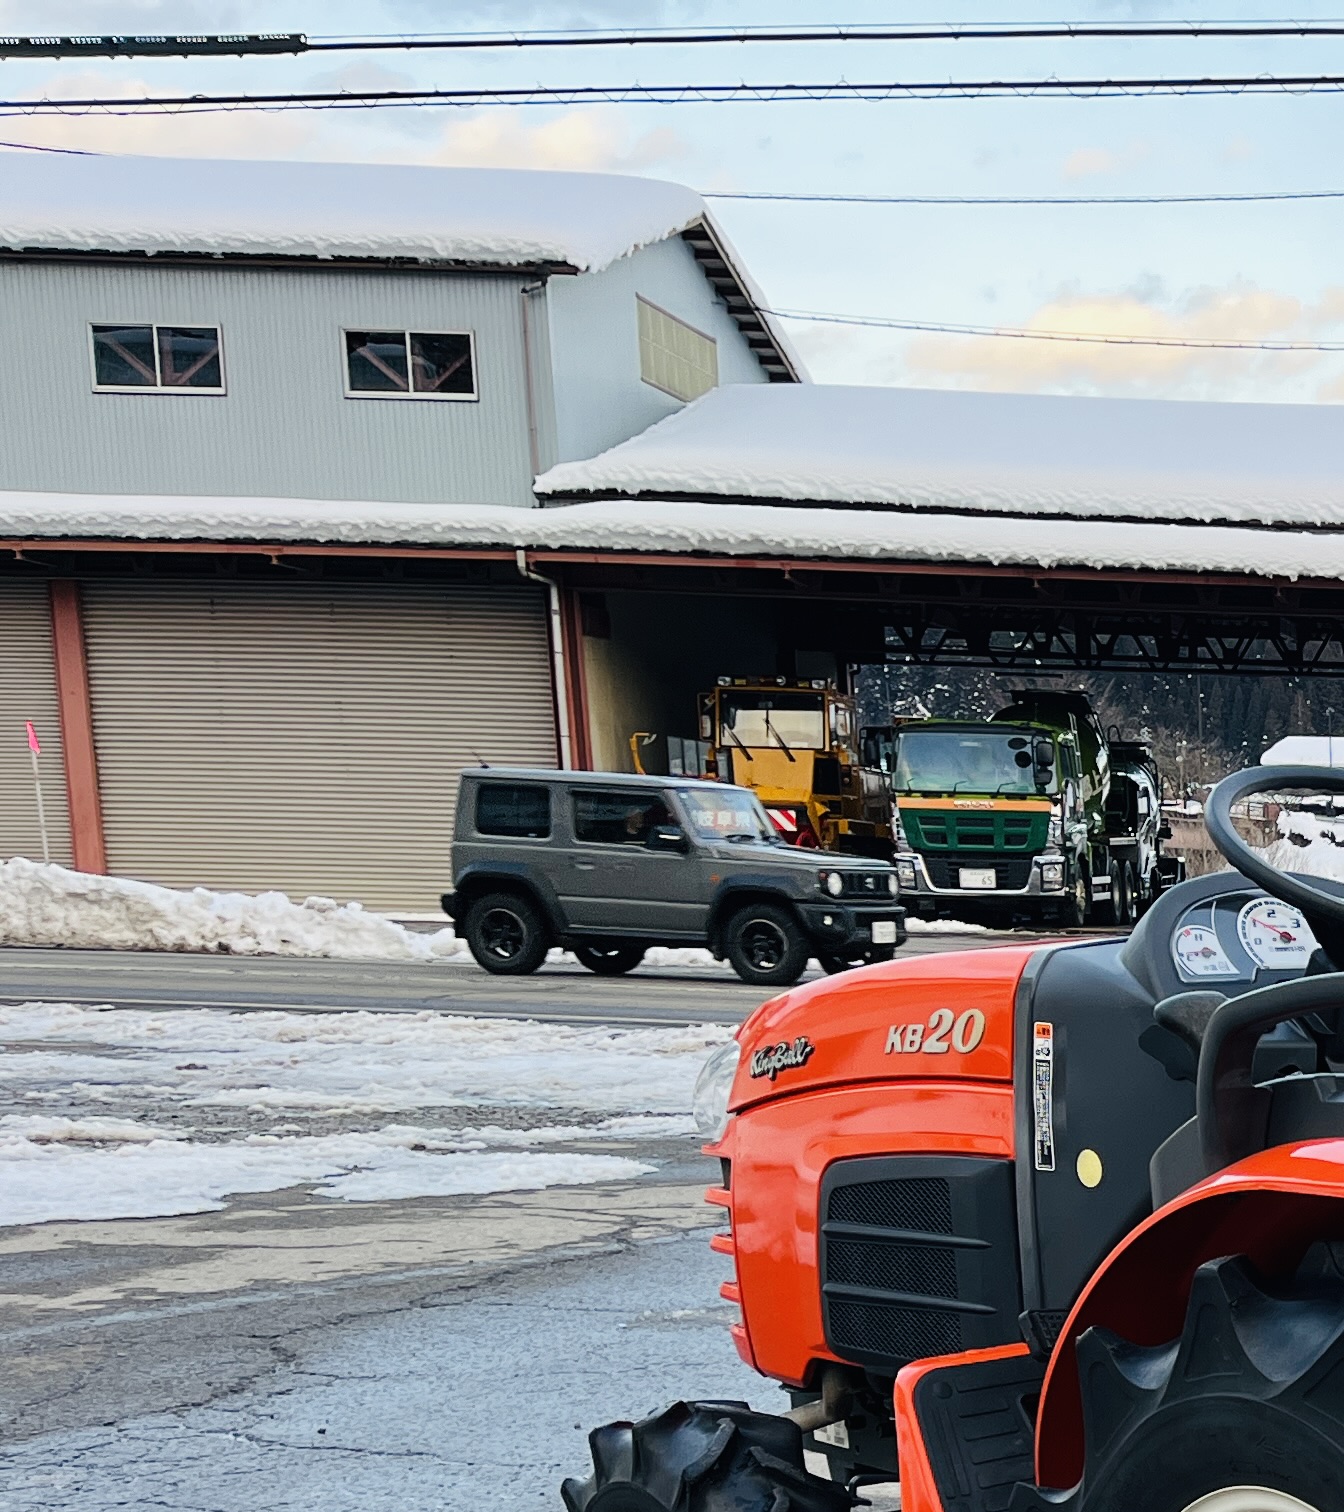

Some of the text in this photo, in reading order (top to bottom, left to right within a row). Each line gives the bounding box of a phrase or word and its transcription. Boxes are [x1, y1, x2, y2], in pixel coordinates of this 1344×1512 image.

[1267, 908, 1277, 918] 2
[1290, 917, 1301, 928] 3
[885, 1008, 986, 1054] KB20
[751, 1037, 815, 1080] KingBull
